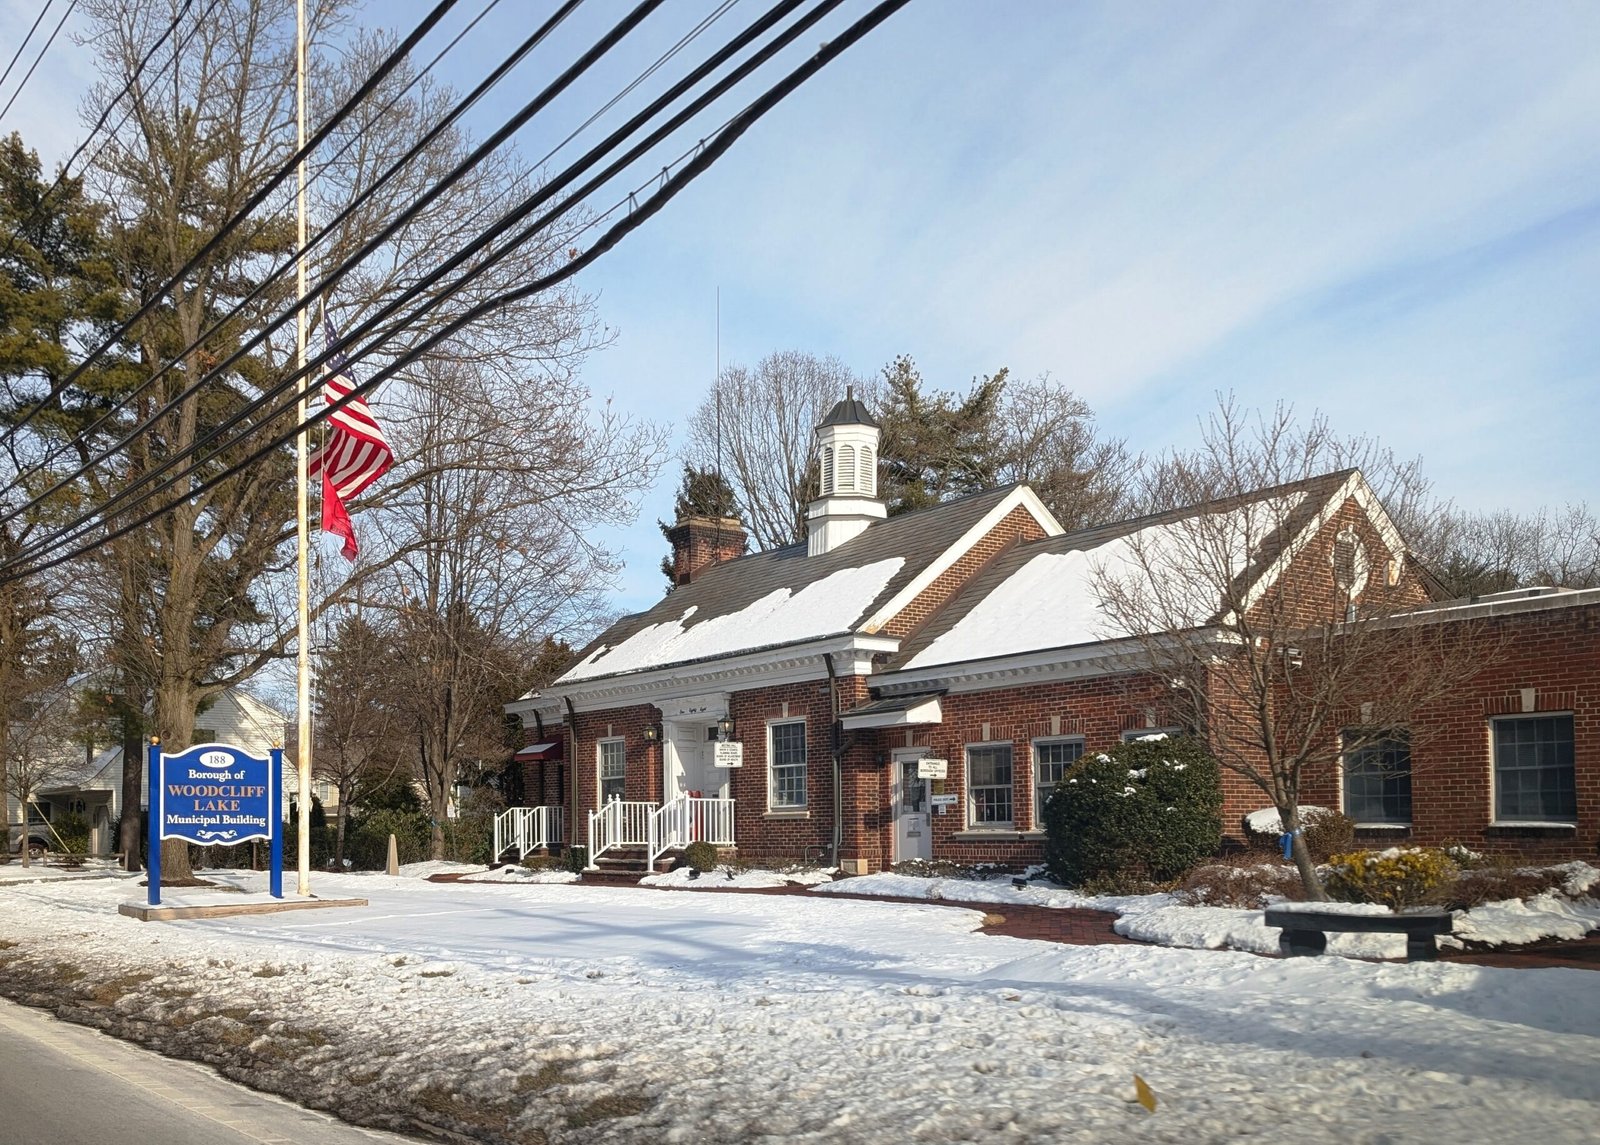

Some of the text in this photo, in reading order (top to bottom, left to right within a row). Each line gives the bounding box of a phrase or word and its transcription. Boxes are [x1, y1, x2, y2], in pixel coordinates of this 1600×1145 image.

[209, 755, 226, 764] 188
[188, 769, 246, 782] Borough of
[168, 784, 266, 797] WOODCLIFF
[194, 799, 240, 811] LAKE
[167, 814, 266, 827] Municipal Building
